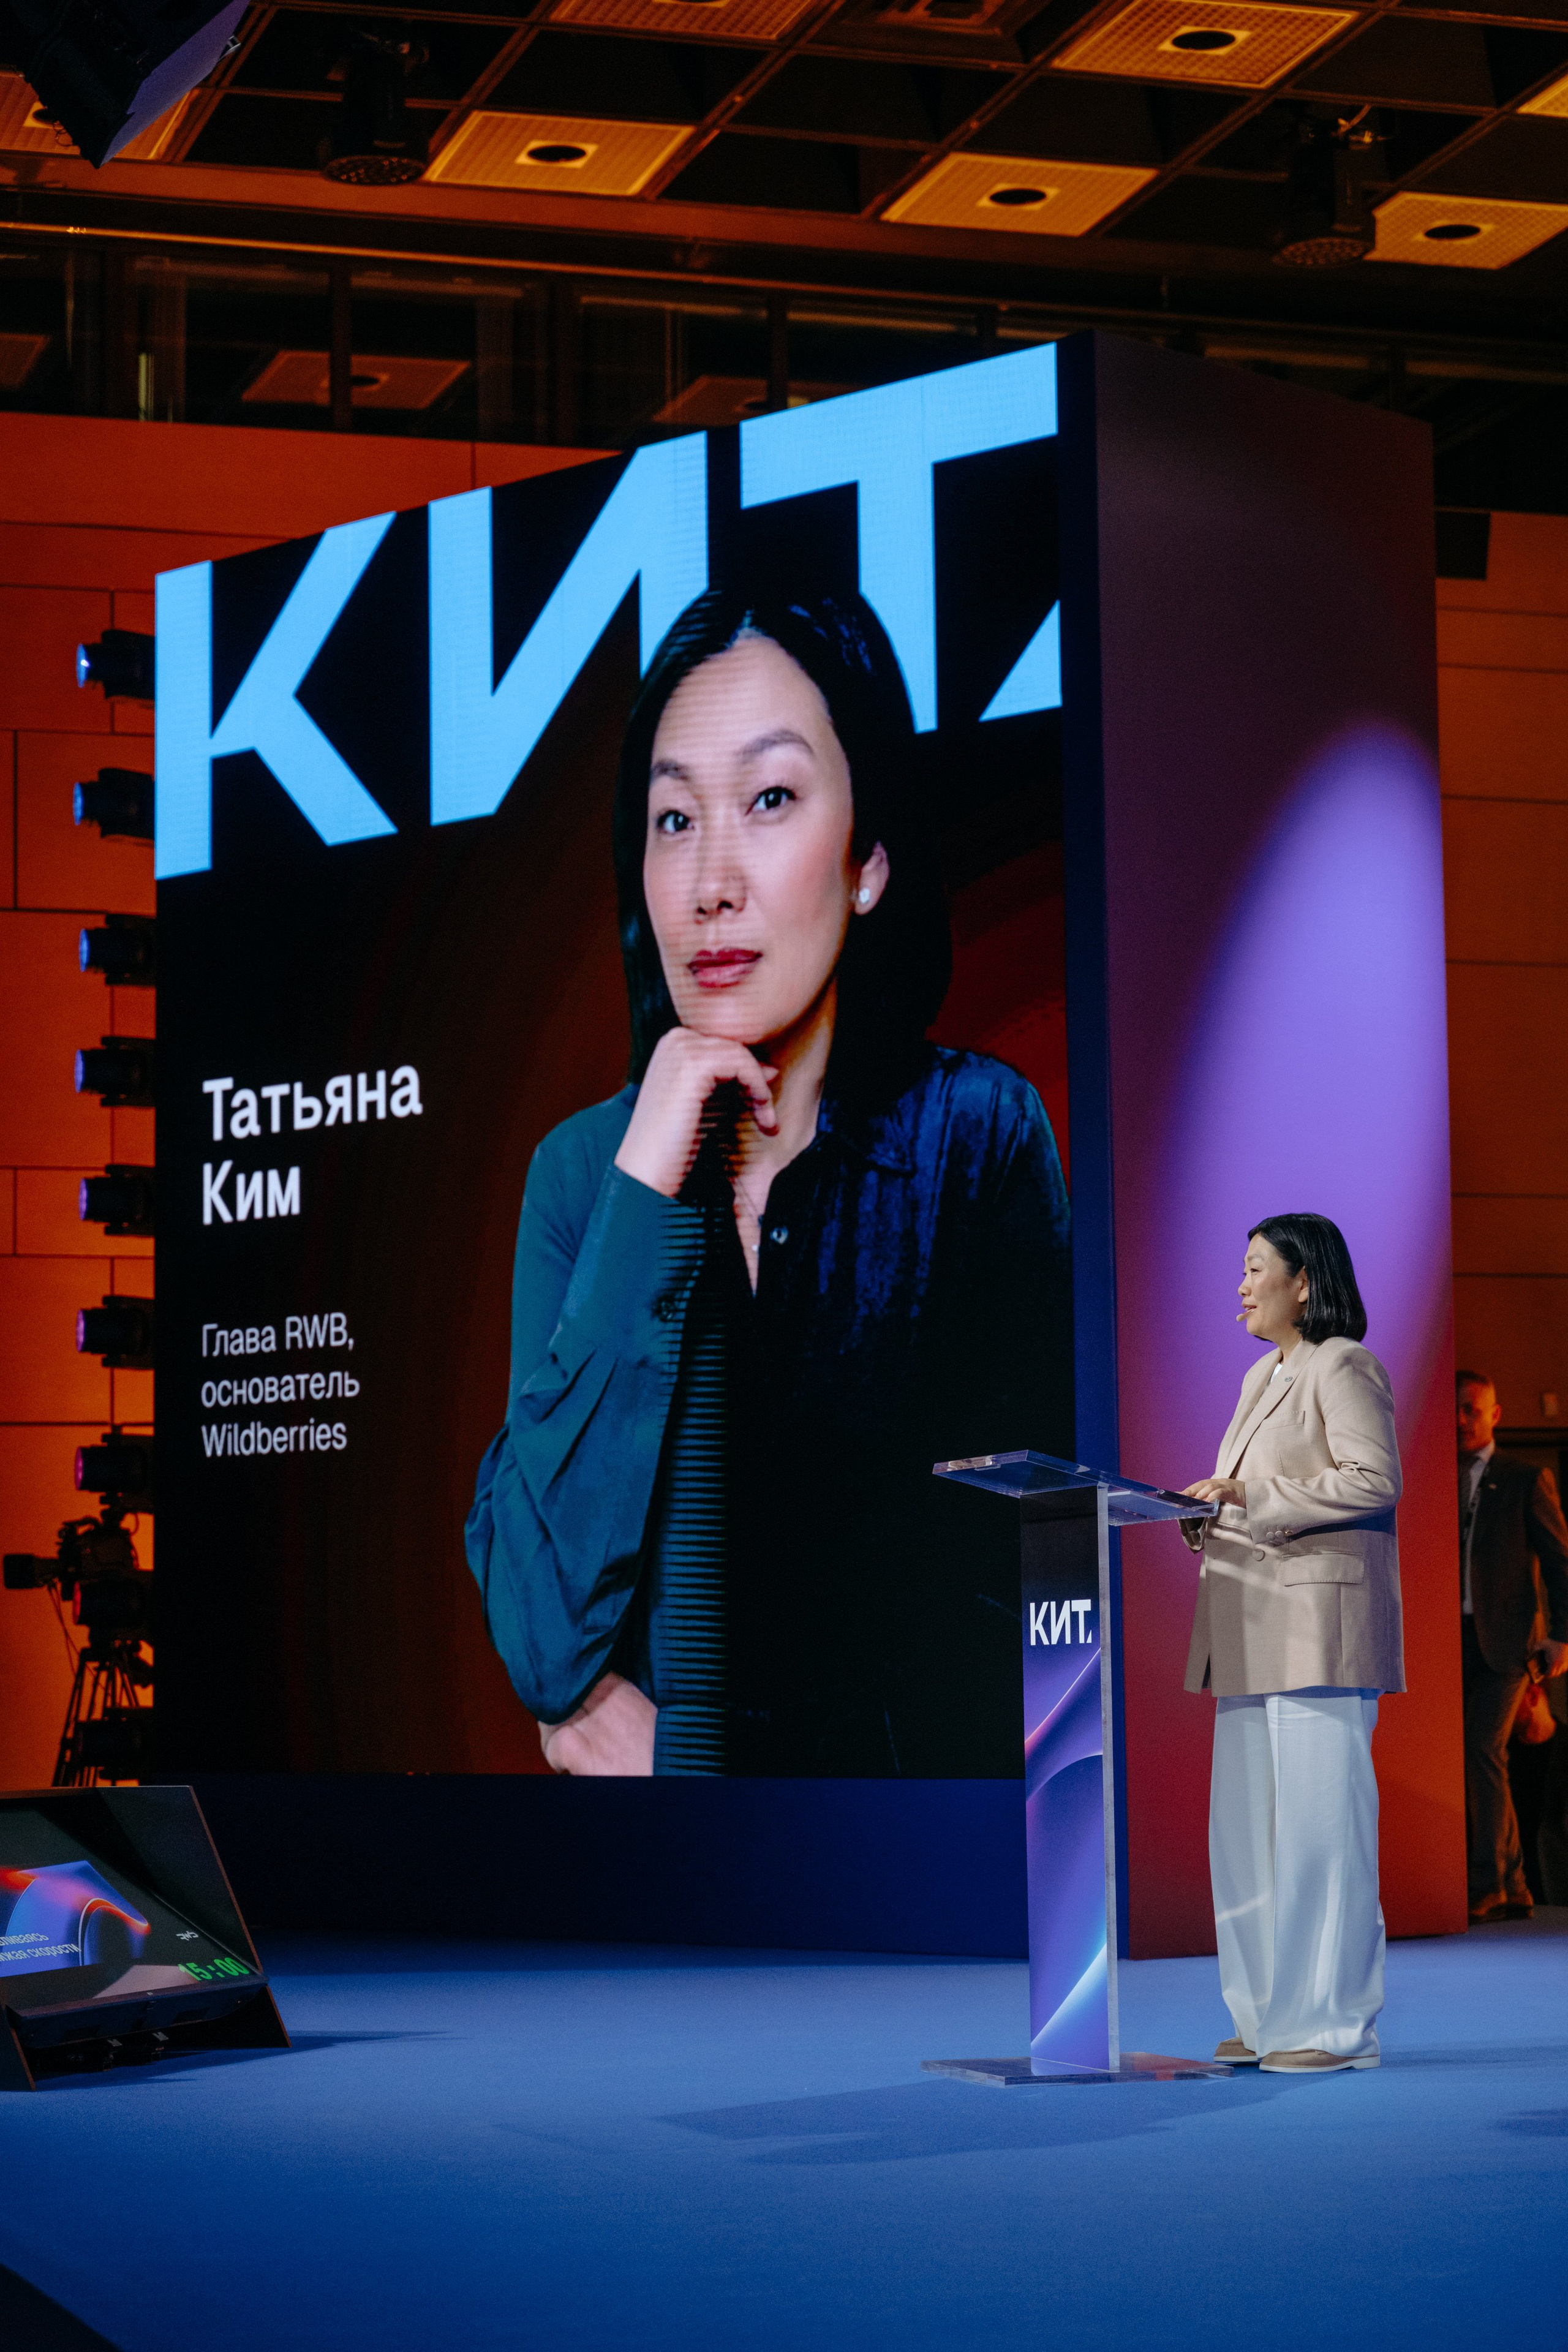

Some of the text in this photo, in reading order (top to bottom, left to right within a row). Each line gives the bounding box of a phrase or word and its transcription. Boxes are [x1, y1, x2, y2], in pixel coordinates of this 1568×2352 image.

[202, 1065, 423, 1141] Татьяна
[203, 1160, 300, 1225] Ким
[202, 1312, 354, 1357] Глава RWB,
[201, 1370, 360, 1408] основатель
[201, 1417, 347, 1457] Wildberries
[26, 1943, 80, 1958] скорости
